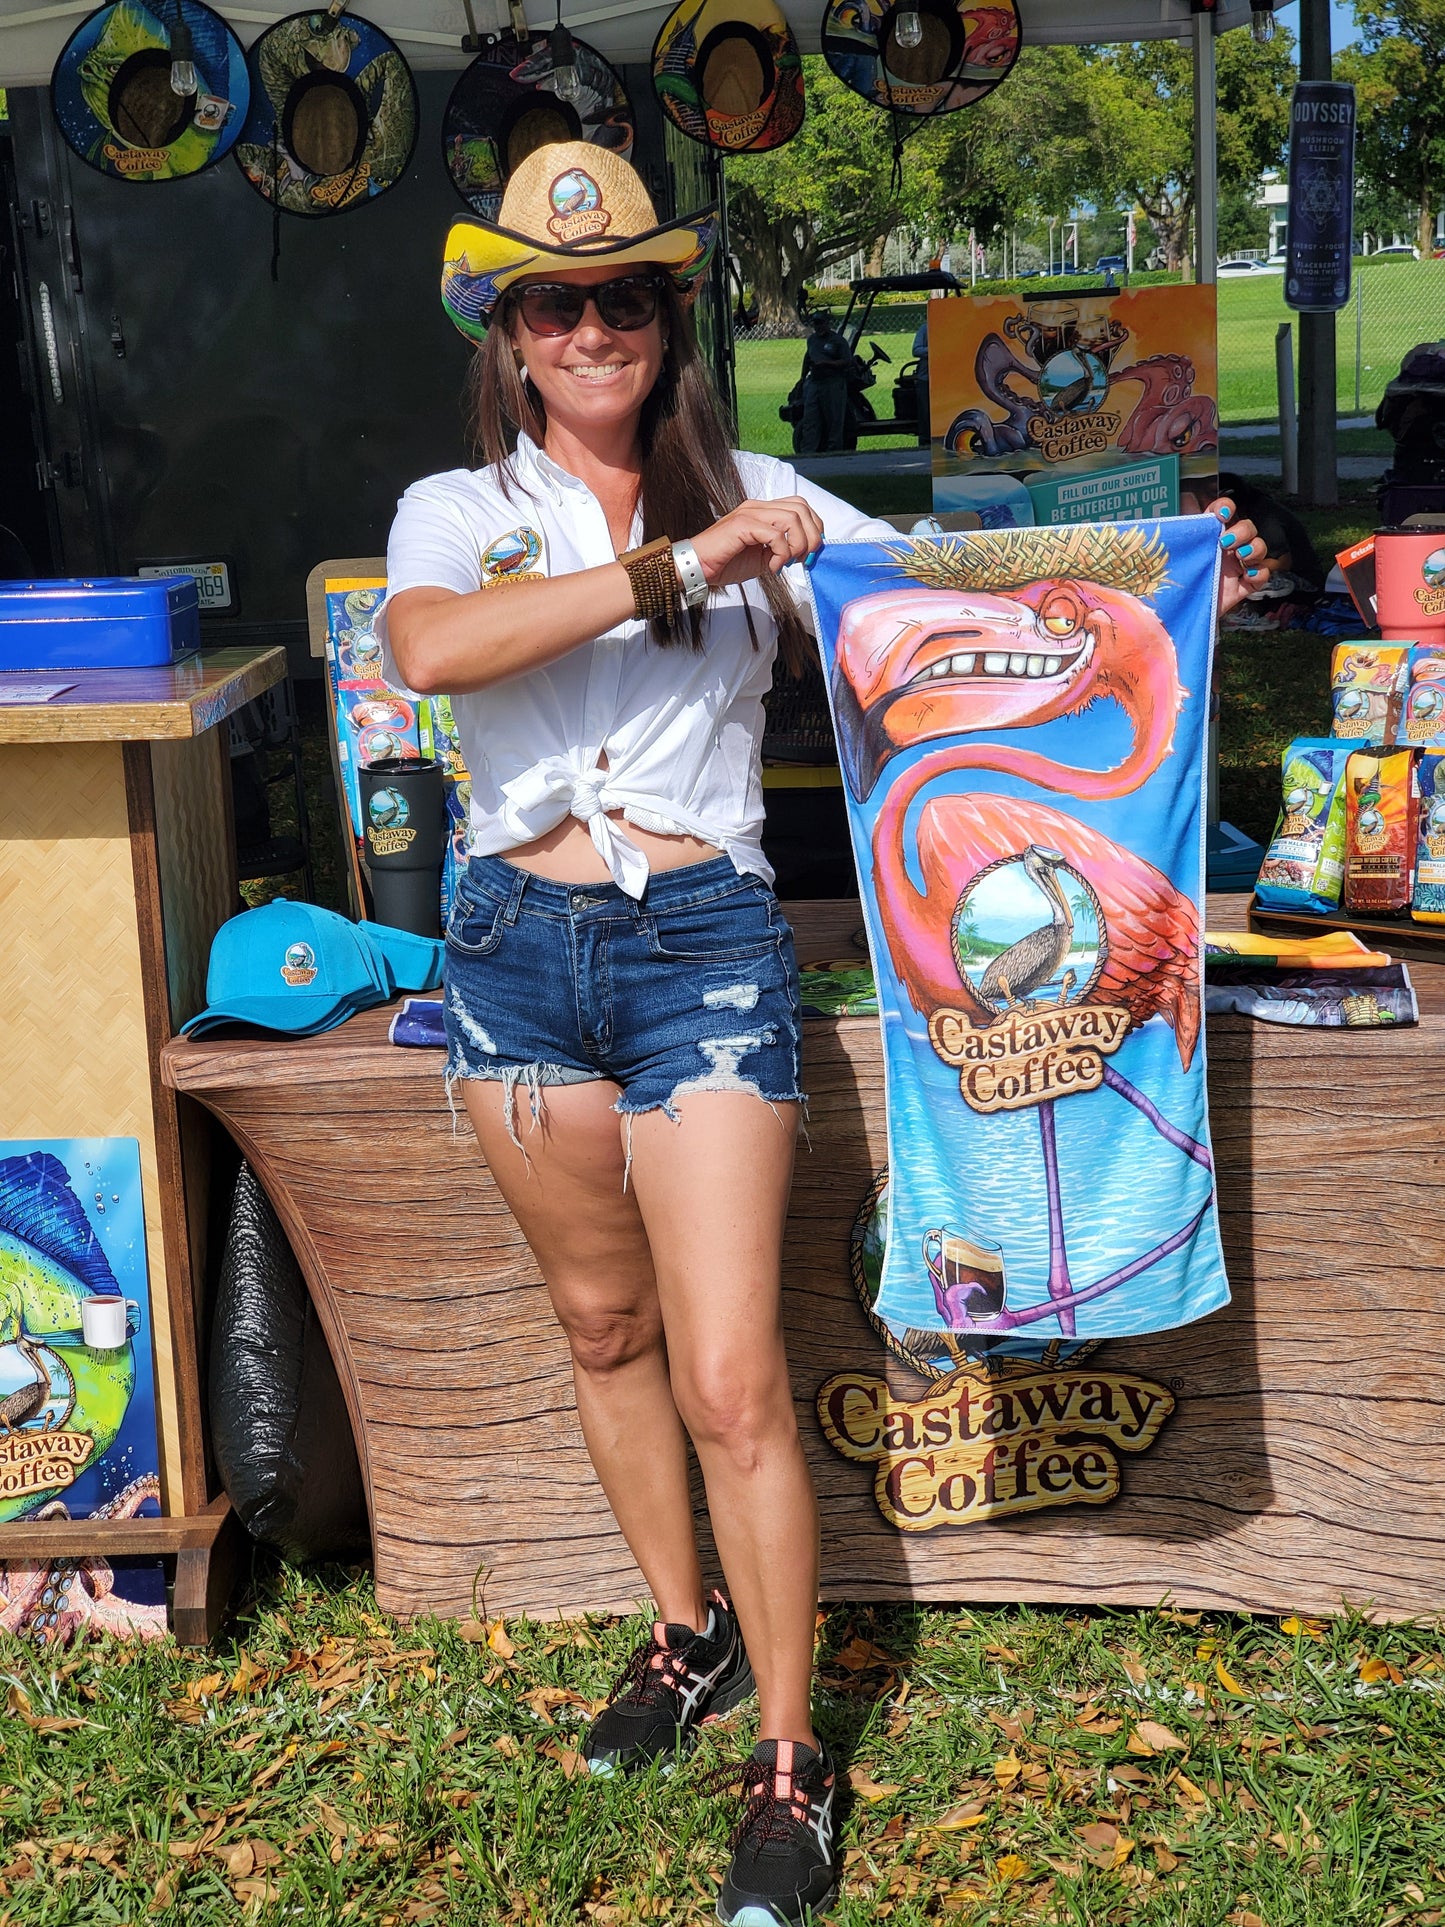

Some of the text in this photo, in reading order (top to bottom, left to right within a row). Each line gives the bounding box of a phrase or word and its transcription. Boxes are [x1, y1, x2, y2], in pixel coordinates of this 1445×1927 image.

[1294, 102, 1353, 124] ODYSSEY
[1301, 136, 1345, 145] MUSHROOM
[1308, 144, 1336, 152] ELIXIR
[105, 145, 169, 161] Castaway
[116, 159, 160, 172] Coffee
[550, 210, 607, 232] Castaway
[562, 222, 602, 241] Coffee
[1031, 415, 1119, 440] Castaway
[1044, 434, 1104, 459] Coffee
[1062, 471, 1157, 500] FILL OUT OUR SURVEY
[1051, 507, 1067, 523] BE
[1069, 495, 1122, 521] ENTERED
[1125, 491, 1138, 506] IN
[1141, 485, 1168, 502] OUR
[367, 827, 415, 842] Castaway
[373, 840, 407, 854] Coffee
[934, 1010, 1125, 1061] Castaway
[966, 1052, 1096, 1104] Coffee
[827, 1378, 1163, 1450] Castaway
[0, 1460, 69, 1492] offee
[884, 1439, 1109, 1518] Coffee
